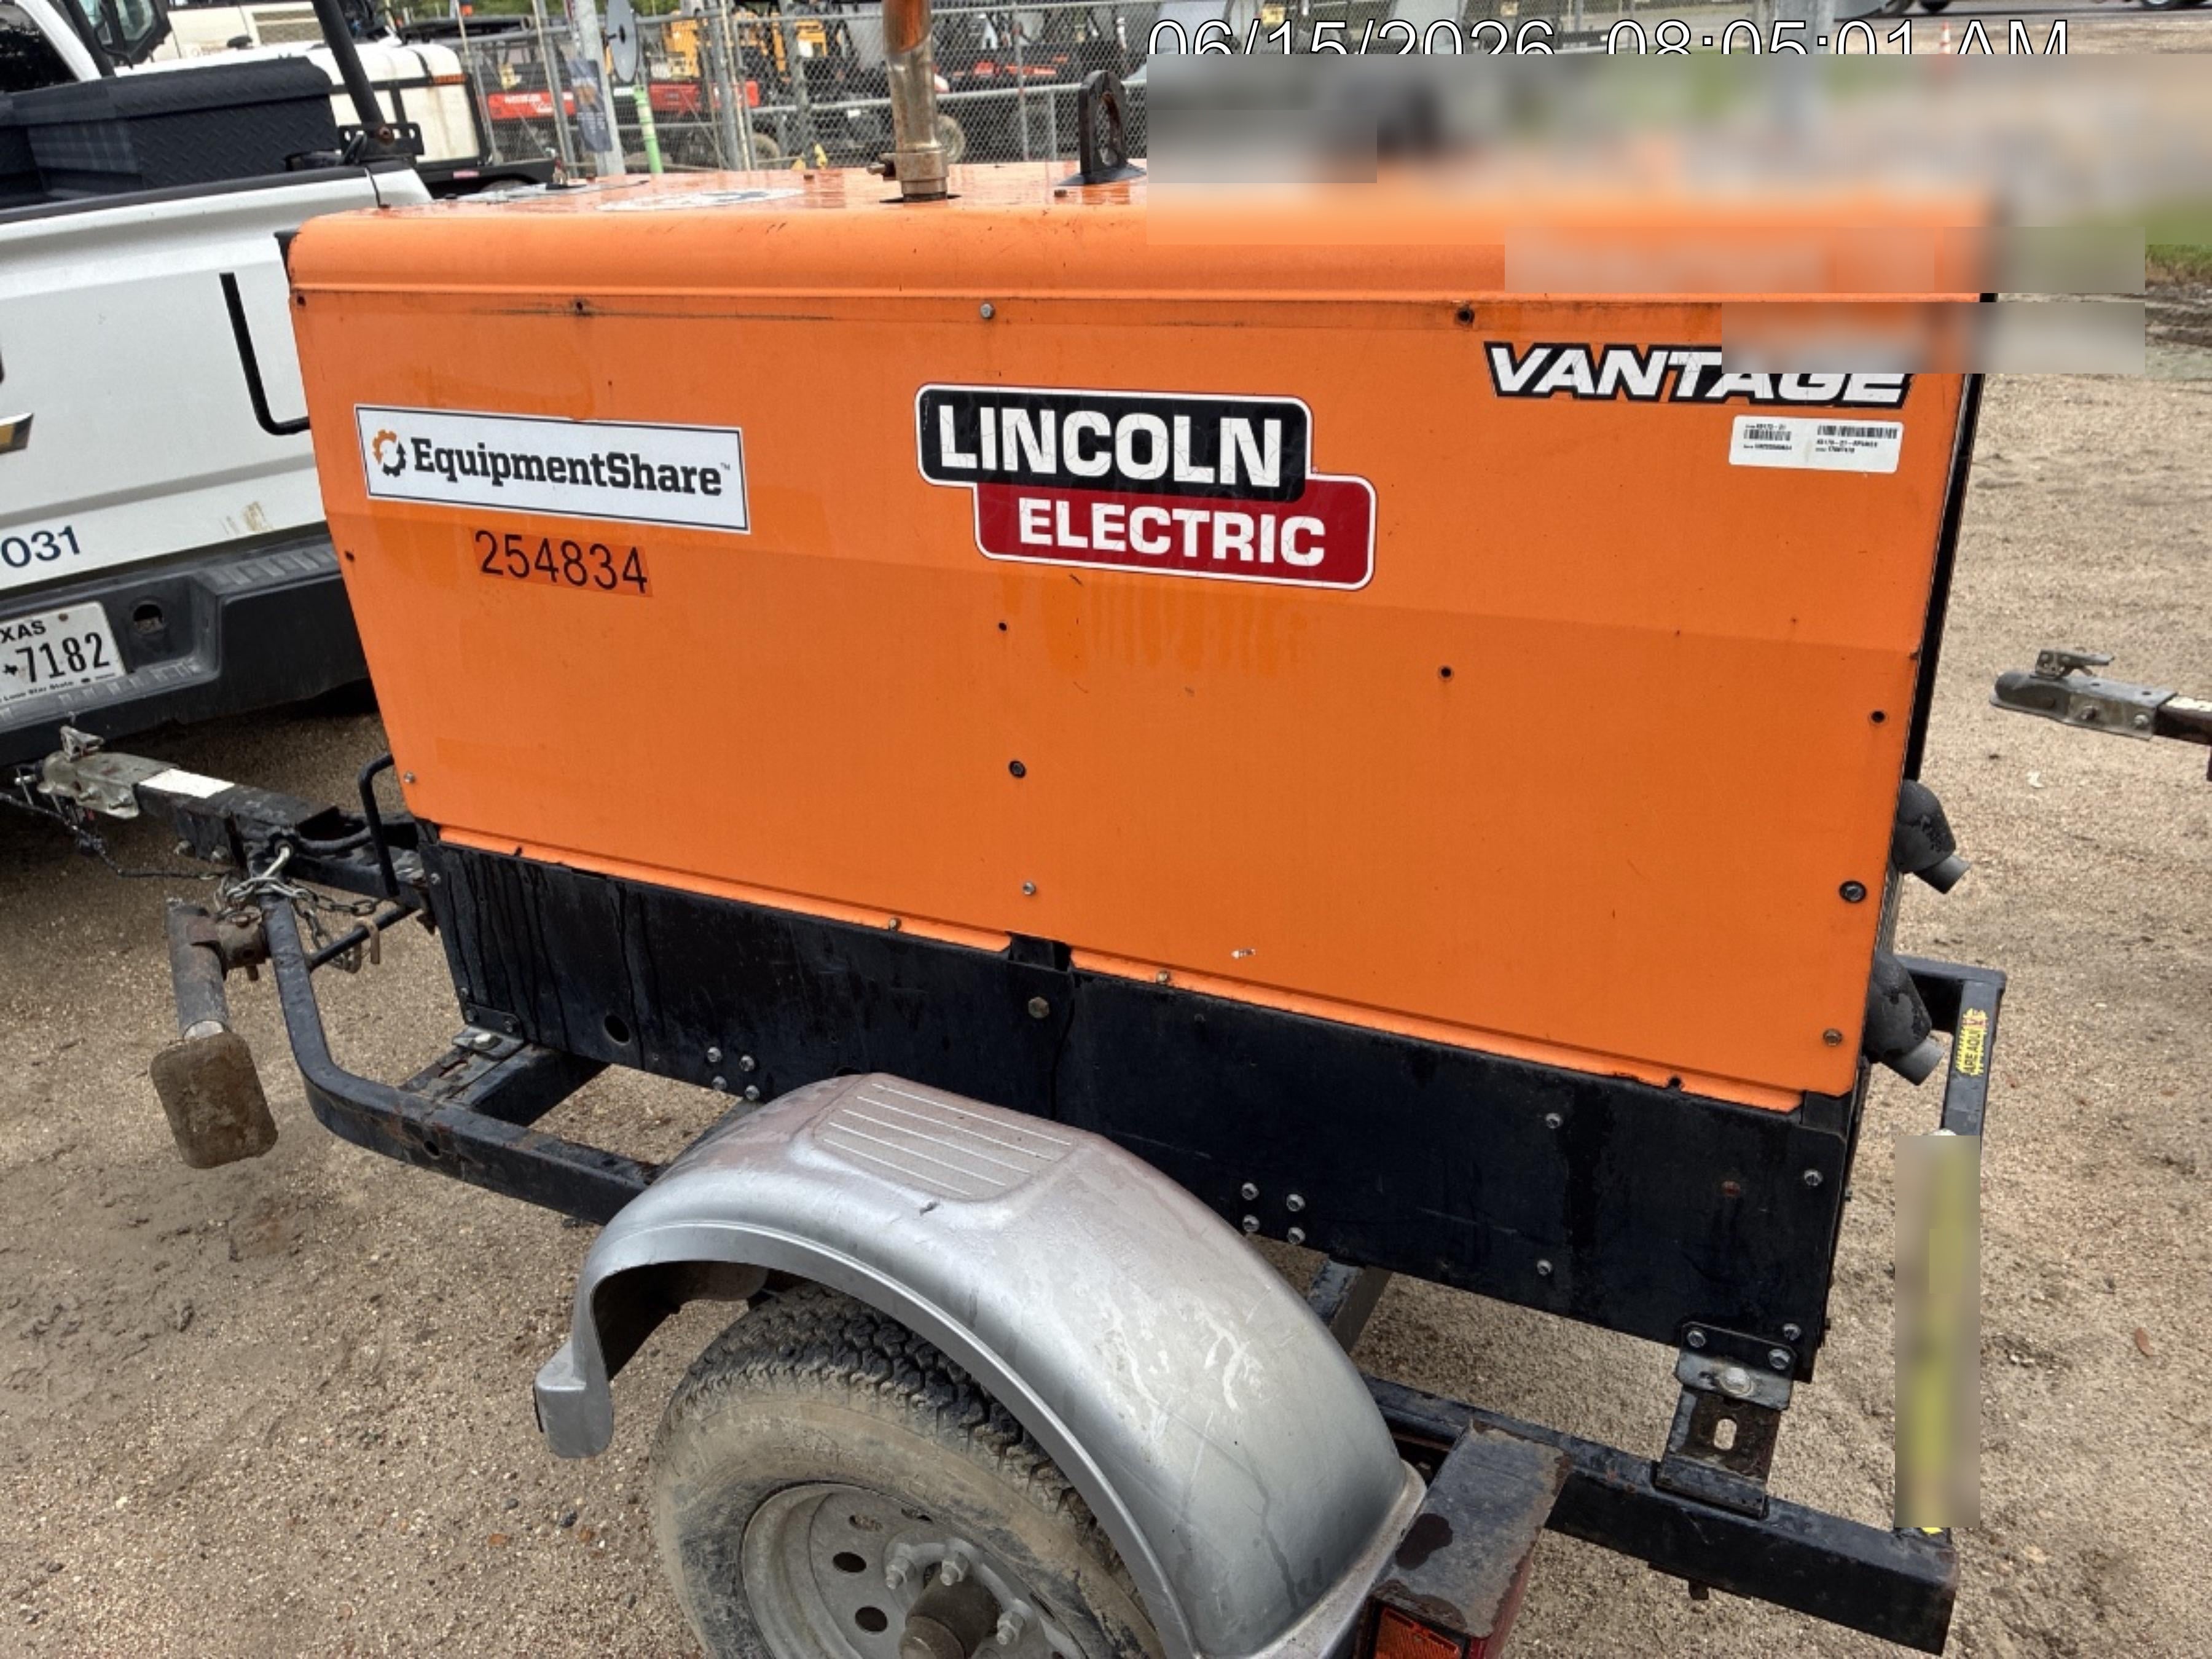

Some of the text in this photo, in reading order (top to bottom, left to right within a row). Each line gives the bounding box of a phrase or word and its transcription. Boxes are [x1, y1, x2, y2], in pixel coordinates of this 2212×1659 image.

[410, 437, 722, 496] EquipmentShare
[938, 404, 1282, 487] LINCOLN
[1, 525, 80, 568] 031
[474, 530, 648, 594] 254834
[1018, 496, 1325, 567] ELECTRIC
[15, 631, 111, 683] 7182
